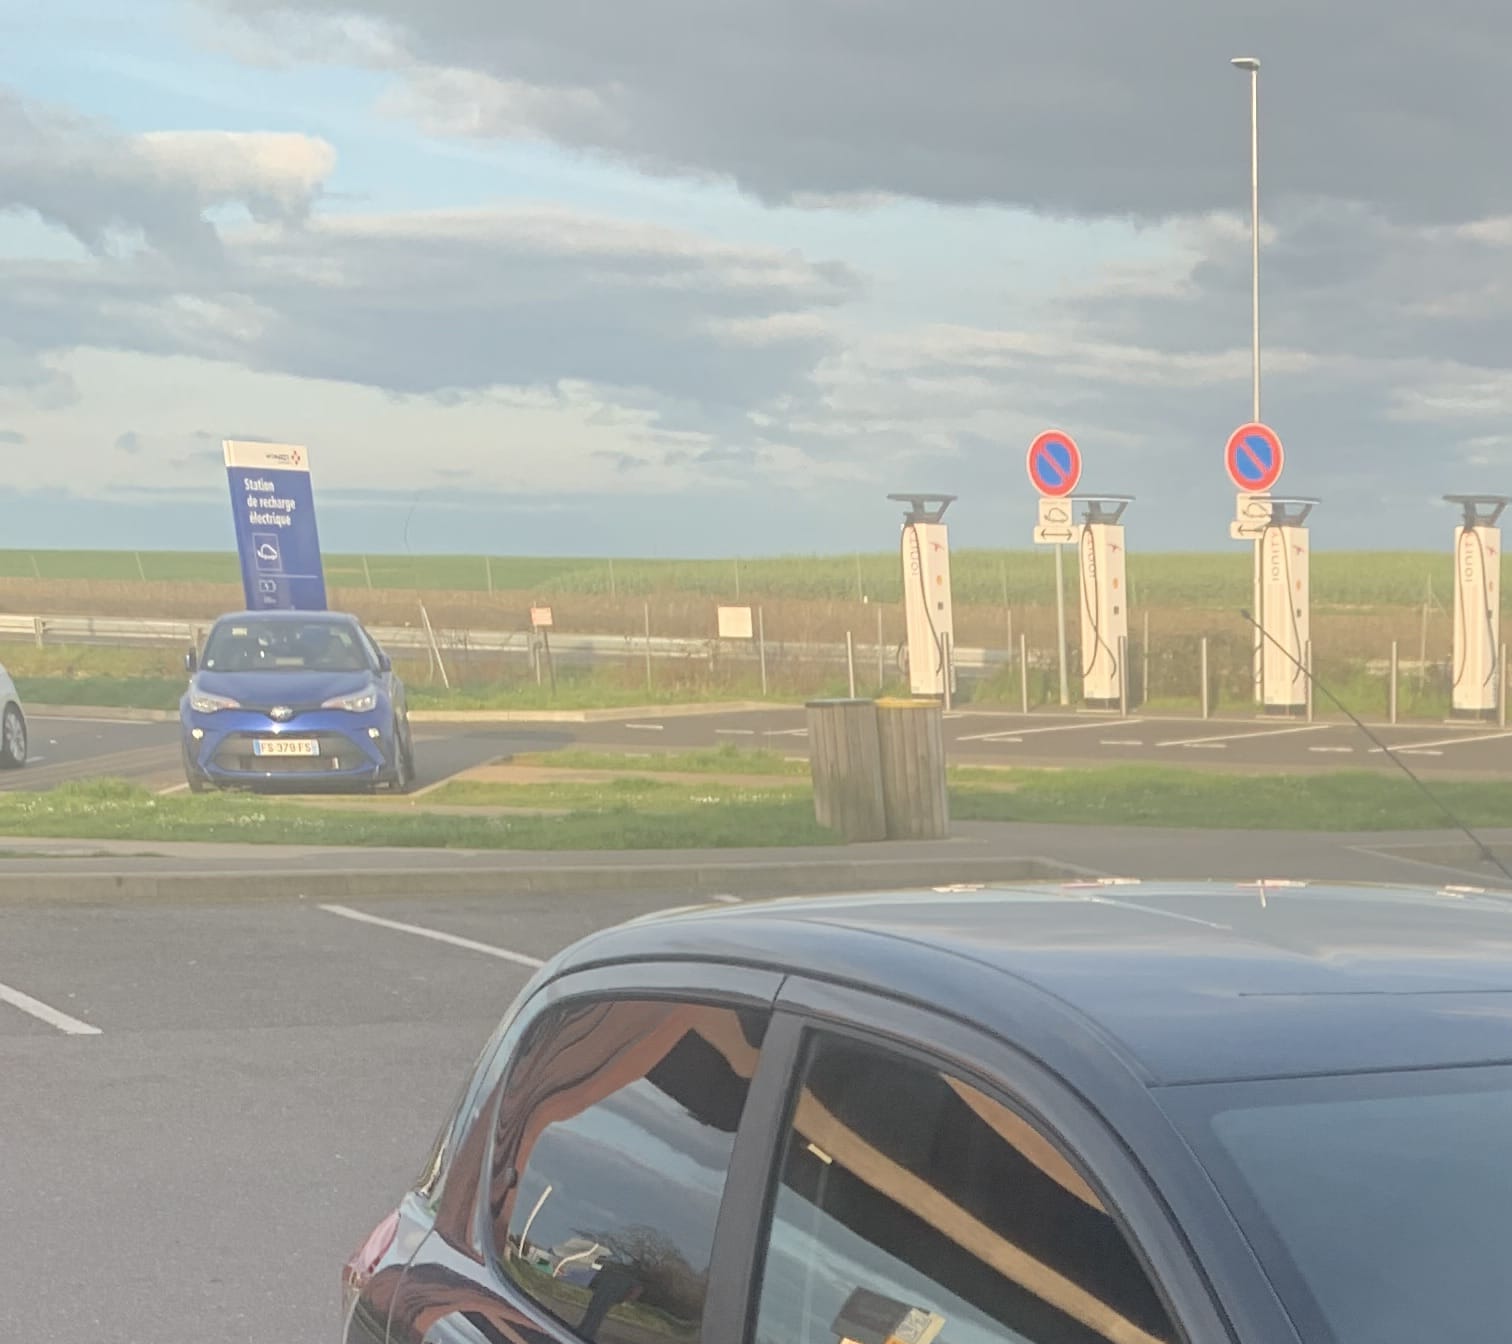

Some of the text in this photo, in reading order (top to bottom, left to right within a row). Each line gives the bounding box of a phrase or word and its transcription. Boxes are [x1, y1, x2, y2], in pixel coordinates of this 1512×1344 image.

[244, 478, 275, 492] Station
[247, 494, 296, 511] de recharge
